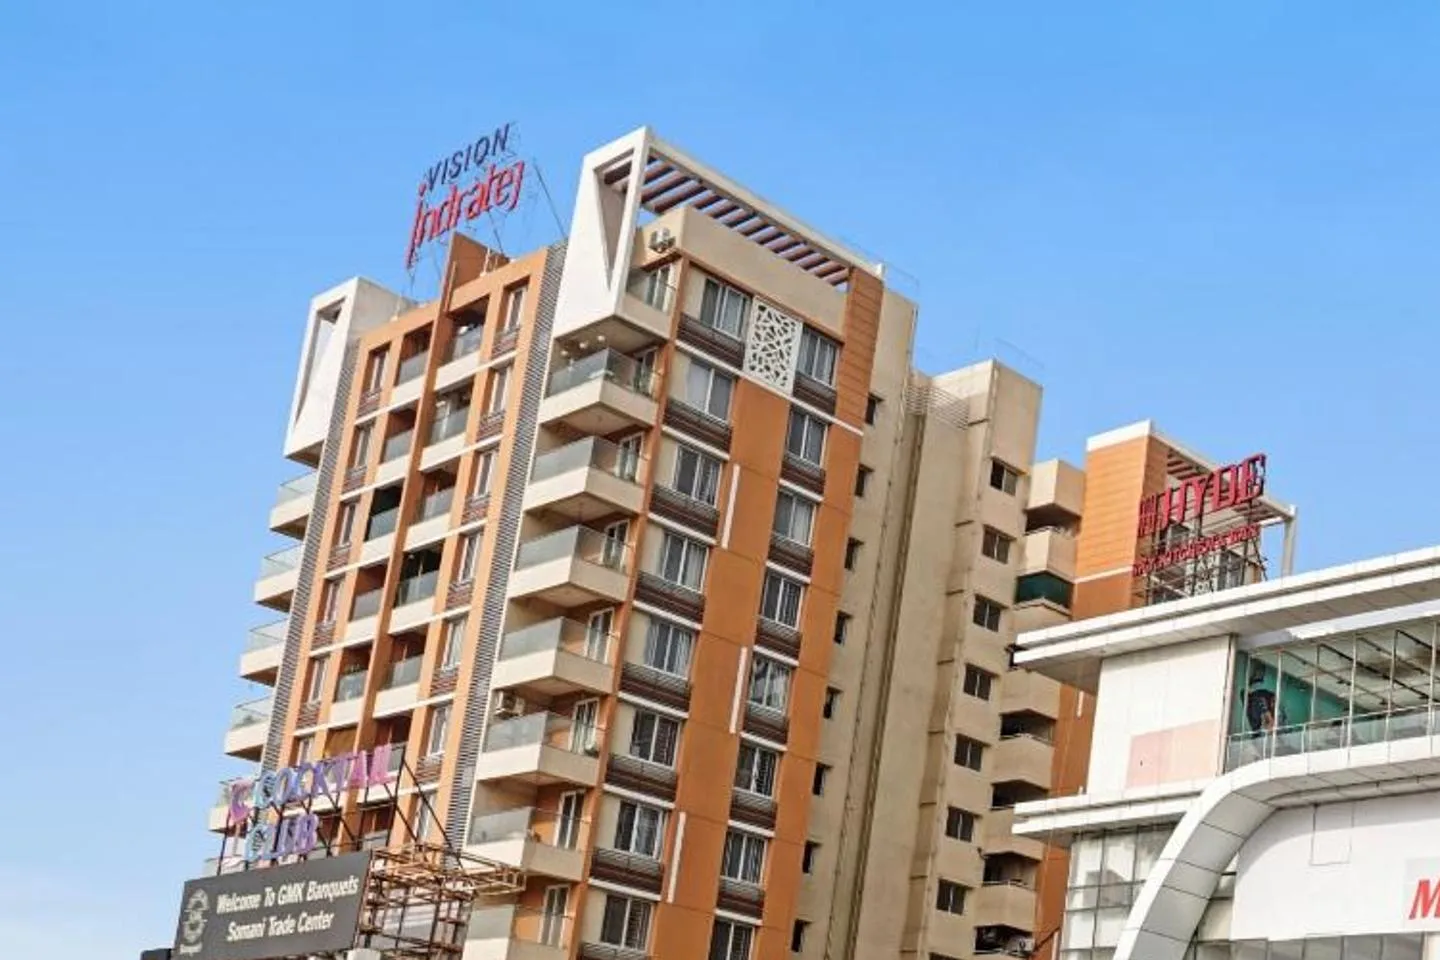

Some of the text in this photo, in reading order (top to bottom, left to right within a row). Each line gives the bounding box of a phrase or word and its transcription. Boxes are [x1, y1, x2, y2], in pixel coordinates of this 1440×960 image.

[428, 123, 510, 191] VISION
[216, 875, 359, 914] Welcome To GMK Banquets
[268, 915, 295, 936] Trade
[297, 910, 335, 932] Center
